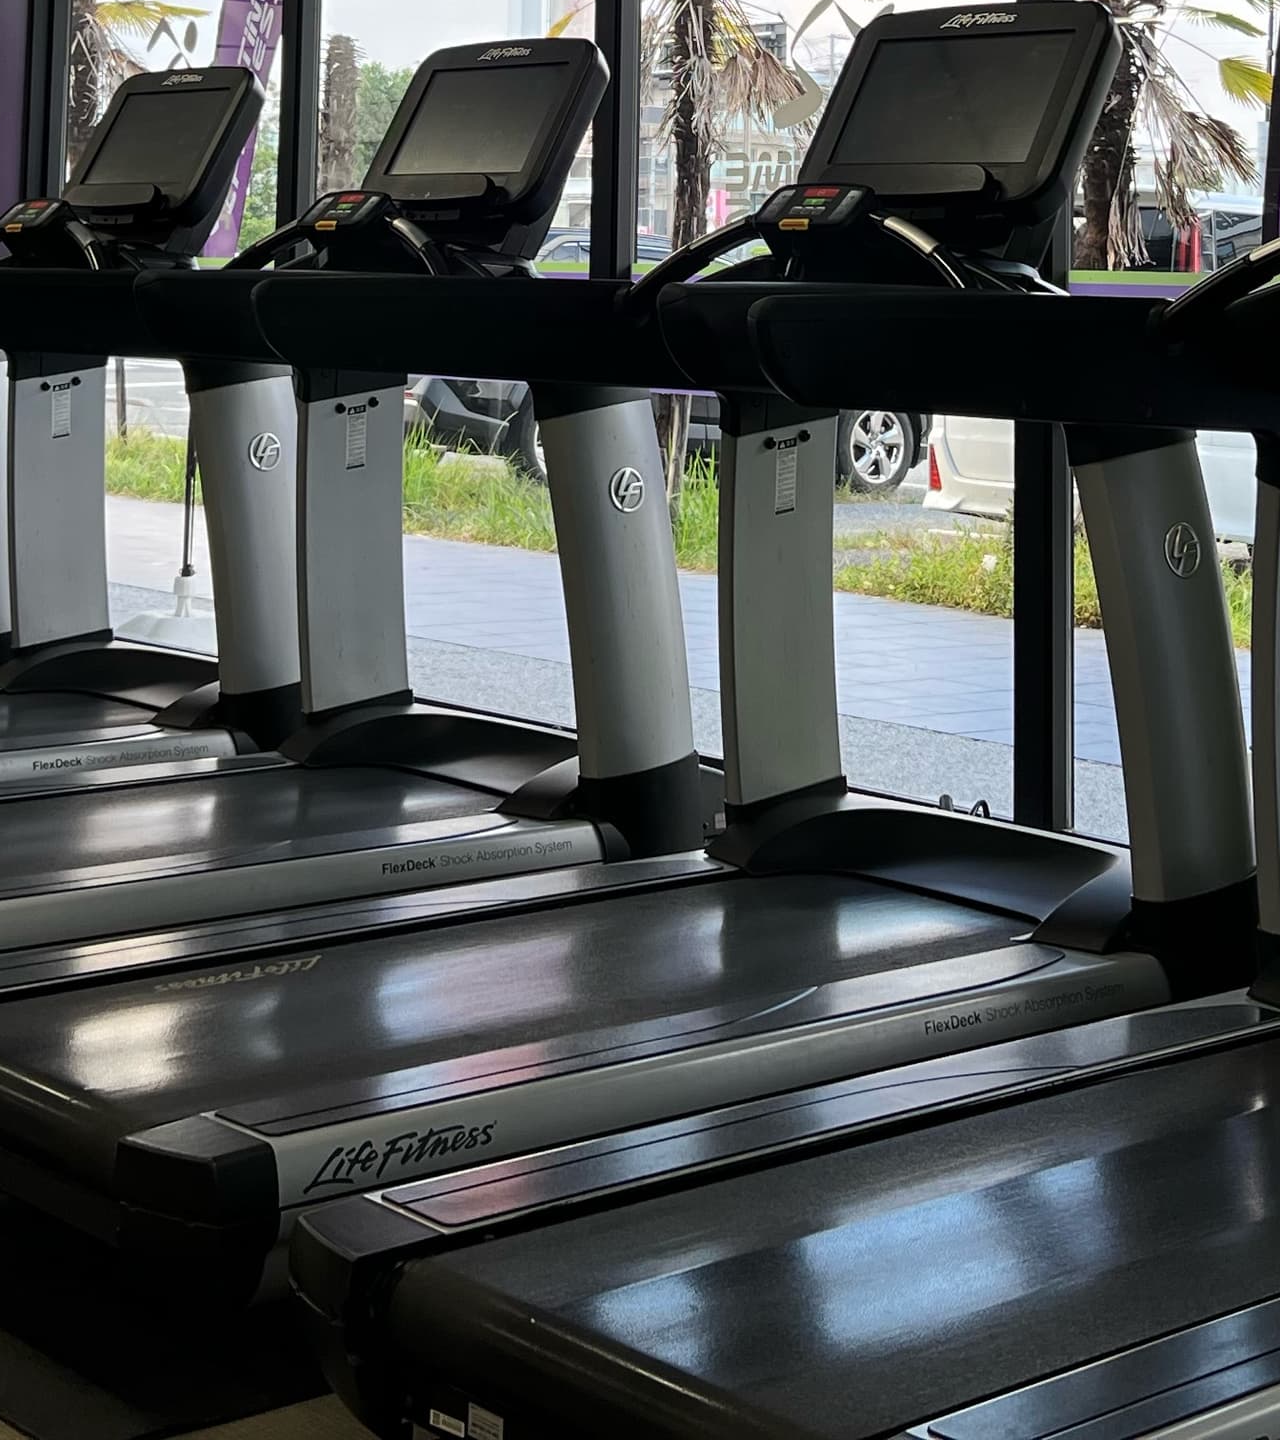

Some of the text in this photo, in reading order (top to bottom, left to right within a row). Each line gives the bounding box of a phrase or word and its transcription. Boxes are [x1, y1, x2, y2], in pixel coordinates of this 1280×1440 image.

[33, 757, 83, 771] FlexDeck
[382, 839, 573, 875] FlexDeck Shock Absorption System
[924, 981, 1126, 1036] FlexDeck Shock Absorption System
[304, 1123, 496, 1194] Life Fitness
